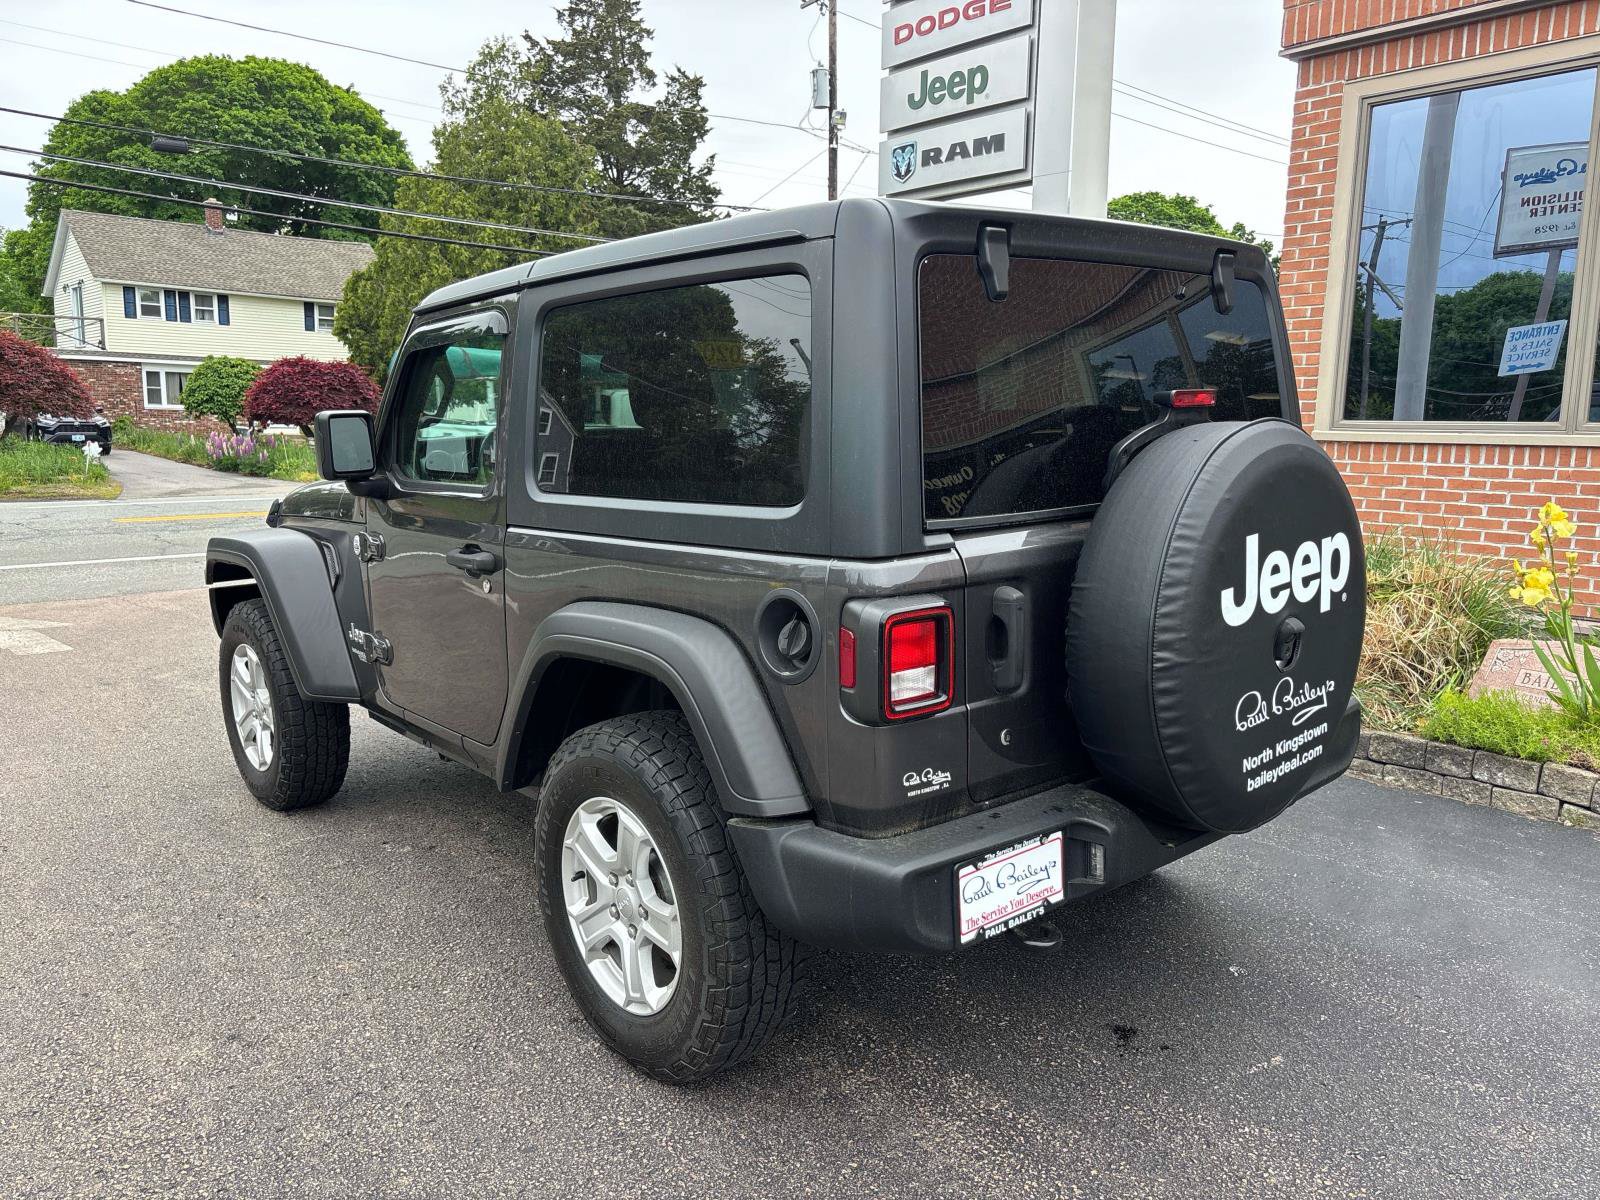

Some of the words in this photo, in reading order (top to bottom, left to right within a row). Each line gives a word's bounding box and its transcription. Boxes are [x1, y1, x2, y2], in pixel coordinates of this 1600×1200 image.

[894, 0, 1012, 45] DODGE
[907, 64, 989, 110] Jeep
[921, 132, 1006, 168] RAM
[1221, 532, 1350, 627] Jeep
[1235, 690, 1270, 731] Paul
[1272, 677, 1335, 726] Bailey's
[1242, 747, 1273, 773] North
[1275, 722, 1328, 757] Kingstown
[1247, 744, 1323, 792] baileydeal.com
[962, 875, 994, 904] Paul
[965, 915, 981, 930] The
[981, 904, 1009, 922] Service
[1009, 898, 1024, 911] You
[985, 924, 1007, 939] PAUL
[1008, 906, 1045, 929] BAILEY'S
